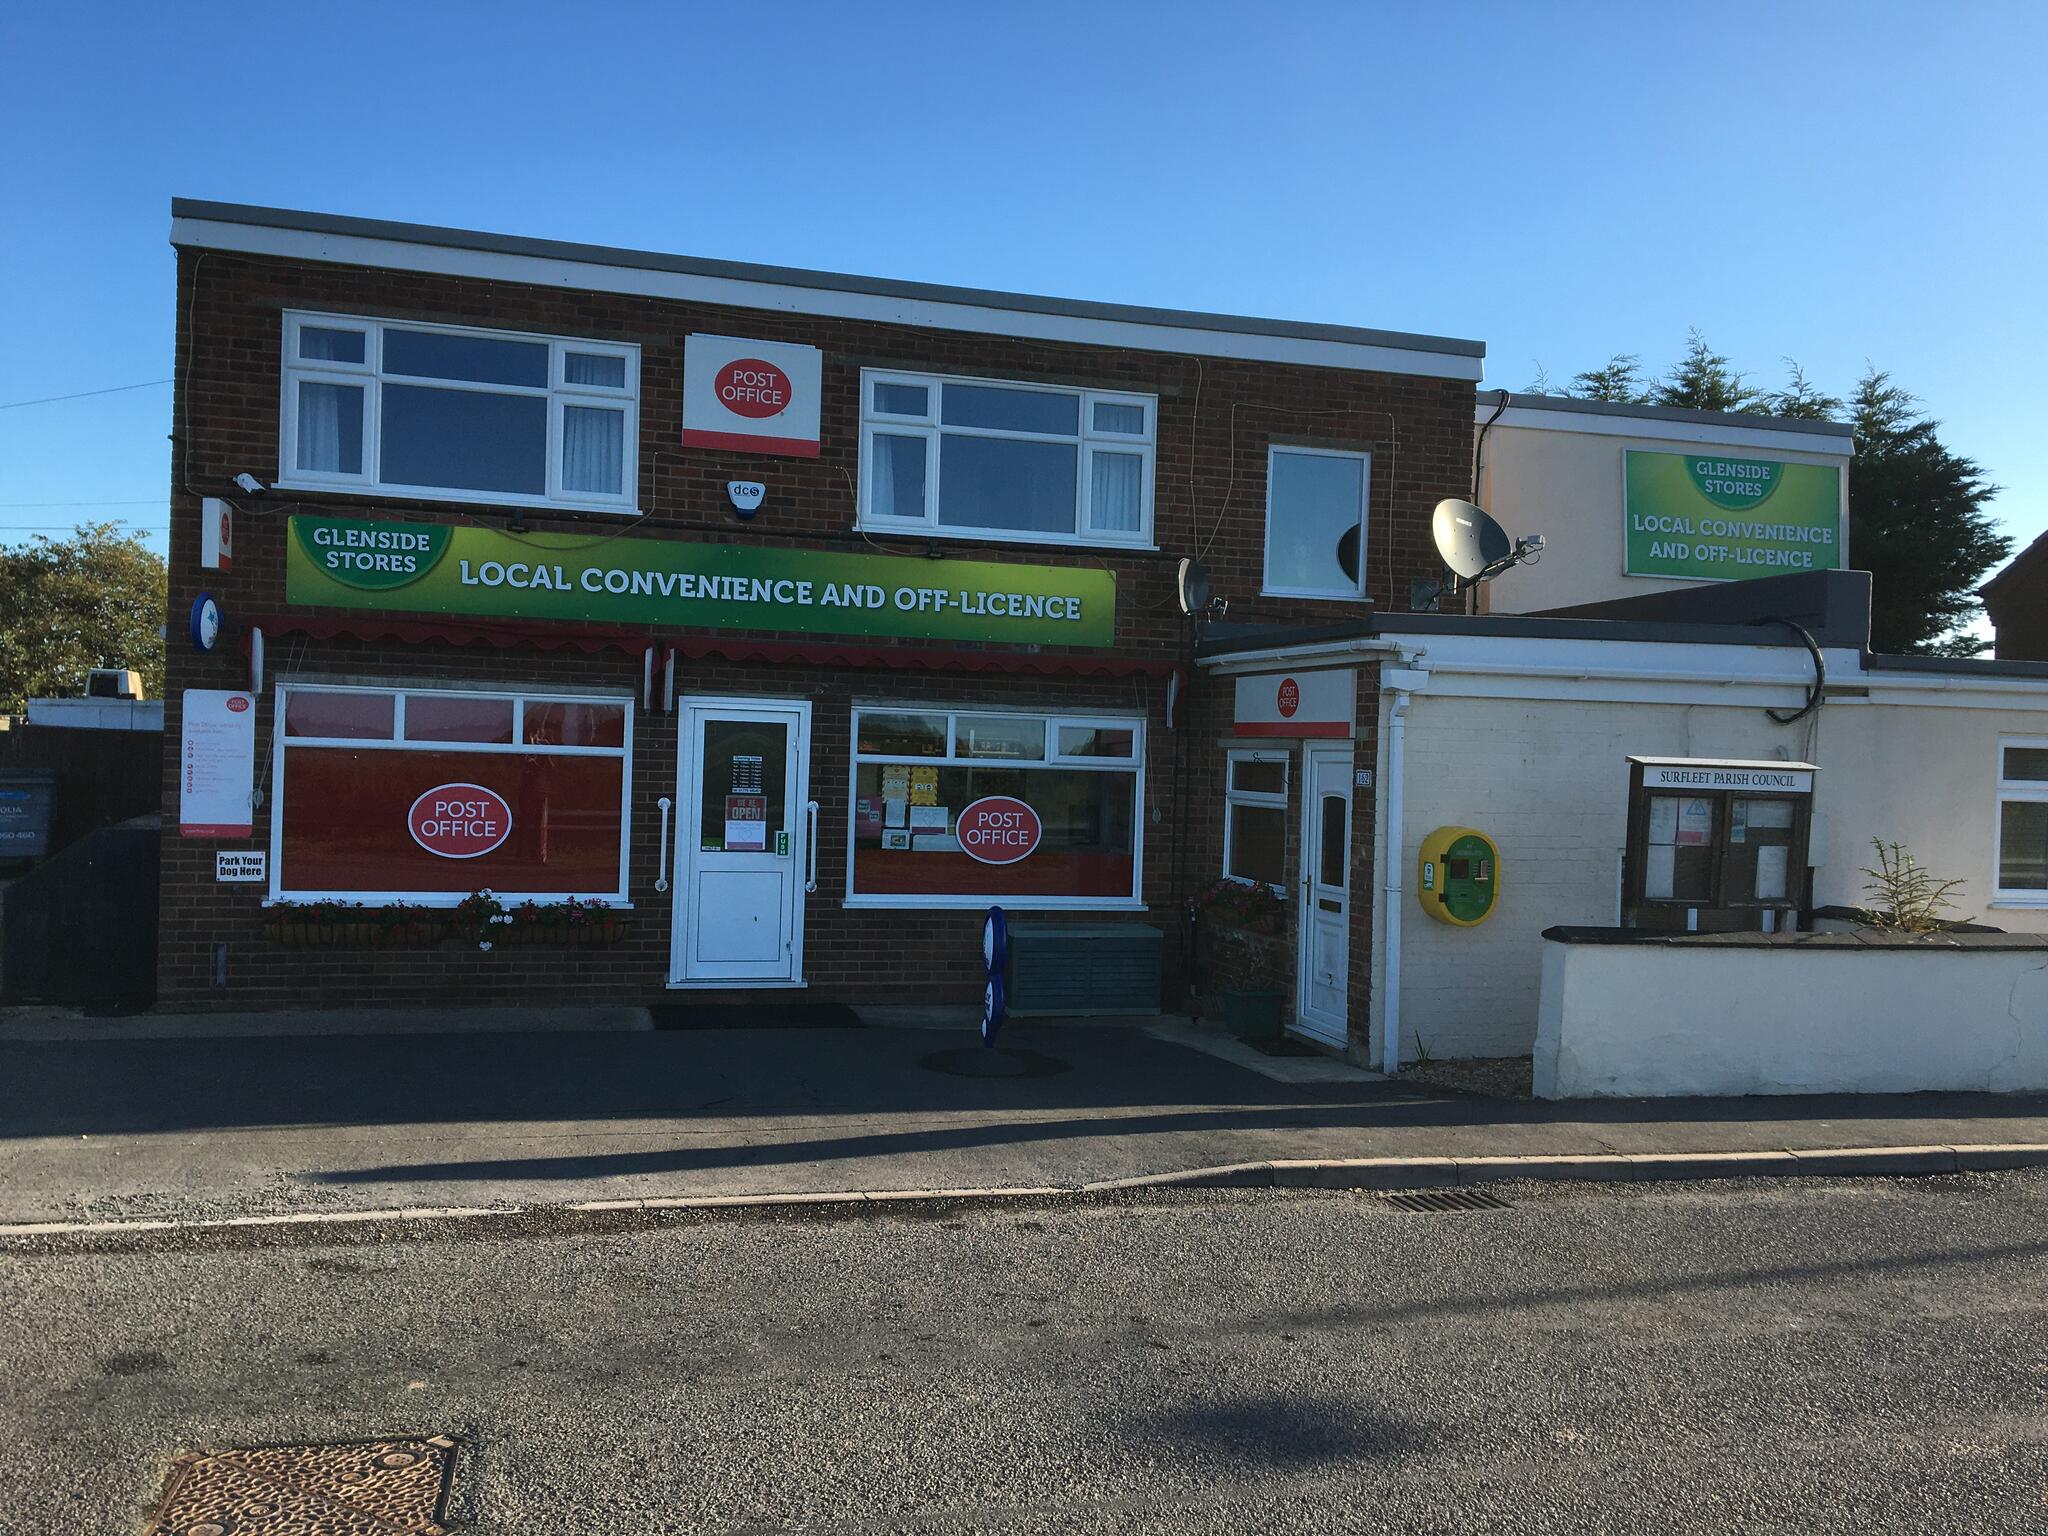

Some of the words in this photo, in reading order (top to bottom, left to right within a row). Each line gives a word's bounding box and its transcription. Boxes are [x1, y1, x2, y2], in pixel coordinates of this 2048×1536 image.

[733, 370, 777, 388] POST
[722, 385, 783, 405] OFFICE
[1697, 461, 1771, 480] GLENSIDE
[733, 484, 760, 497] dcs
[1705, 480, 1763, 497] STORES
[1633, 513, 1696, 535] LOCAL
[1700, 519, 1833, 544] CONVENIENCE
[313, 527, 430, 551] GLENSIDE
[326, 551, 417, 573] STORES
[1649, 541, 1690, 560] AND
[1694, 543, 1813, 568] OFF-LICENCE
[459, 559, 572, 591] LOCAL
[580, 566, 814, 605] CONVENIENCE
[820, 582, 886, 610] AND
[893, 586, 1081, 620] OFF-LICENCE
[1282, 686, 1296, 697] POST
[1279, 697, 1297, 708] OFFICE
[1660, 770, 1712, 784] SURFLEET
[1713, 772, 1750, 785] PARISH
[1752, 774, 1796, 787] COUNCIL
[435, 801, 490, 818] POST
[731, 806, 761, 820] OPEN
[421, 820, 497, 837] OFFICE
[978, 812, 1024, 828] POST
[966, 829, 1029, 845] OFFICE
[219, 856, 240, 865] Park
[242, 856, 263, 865] Your
[220, 866, 238, 876] Dog
[240, 866, 262, 876] Here
